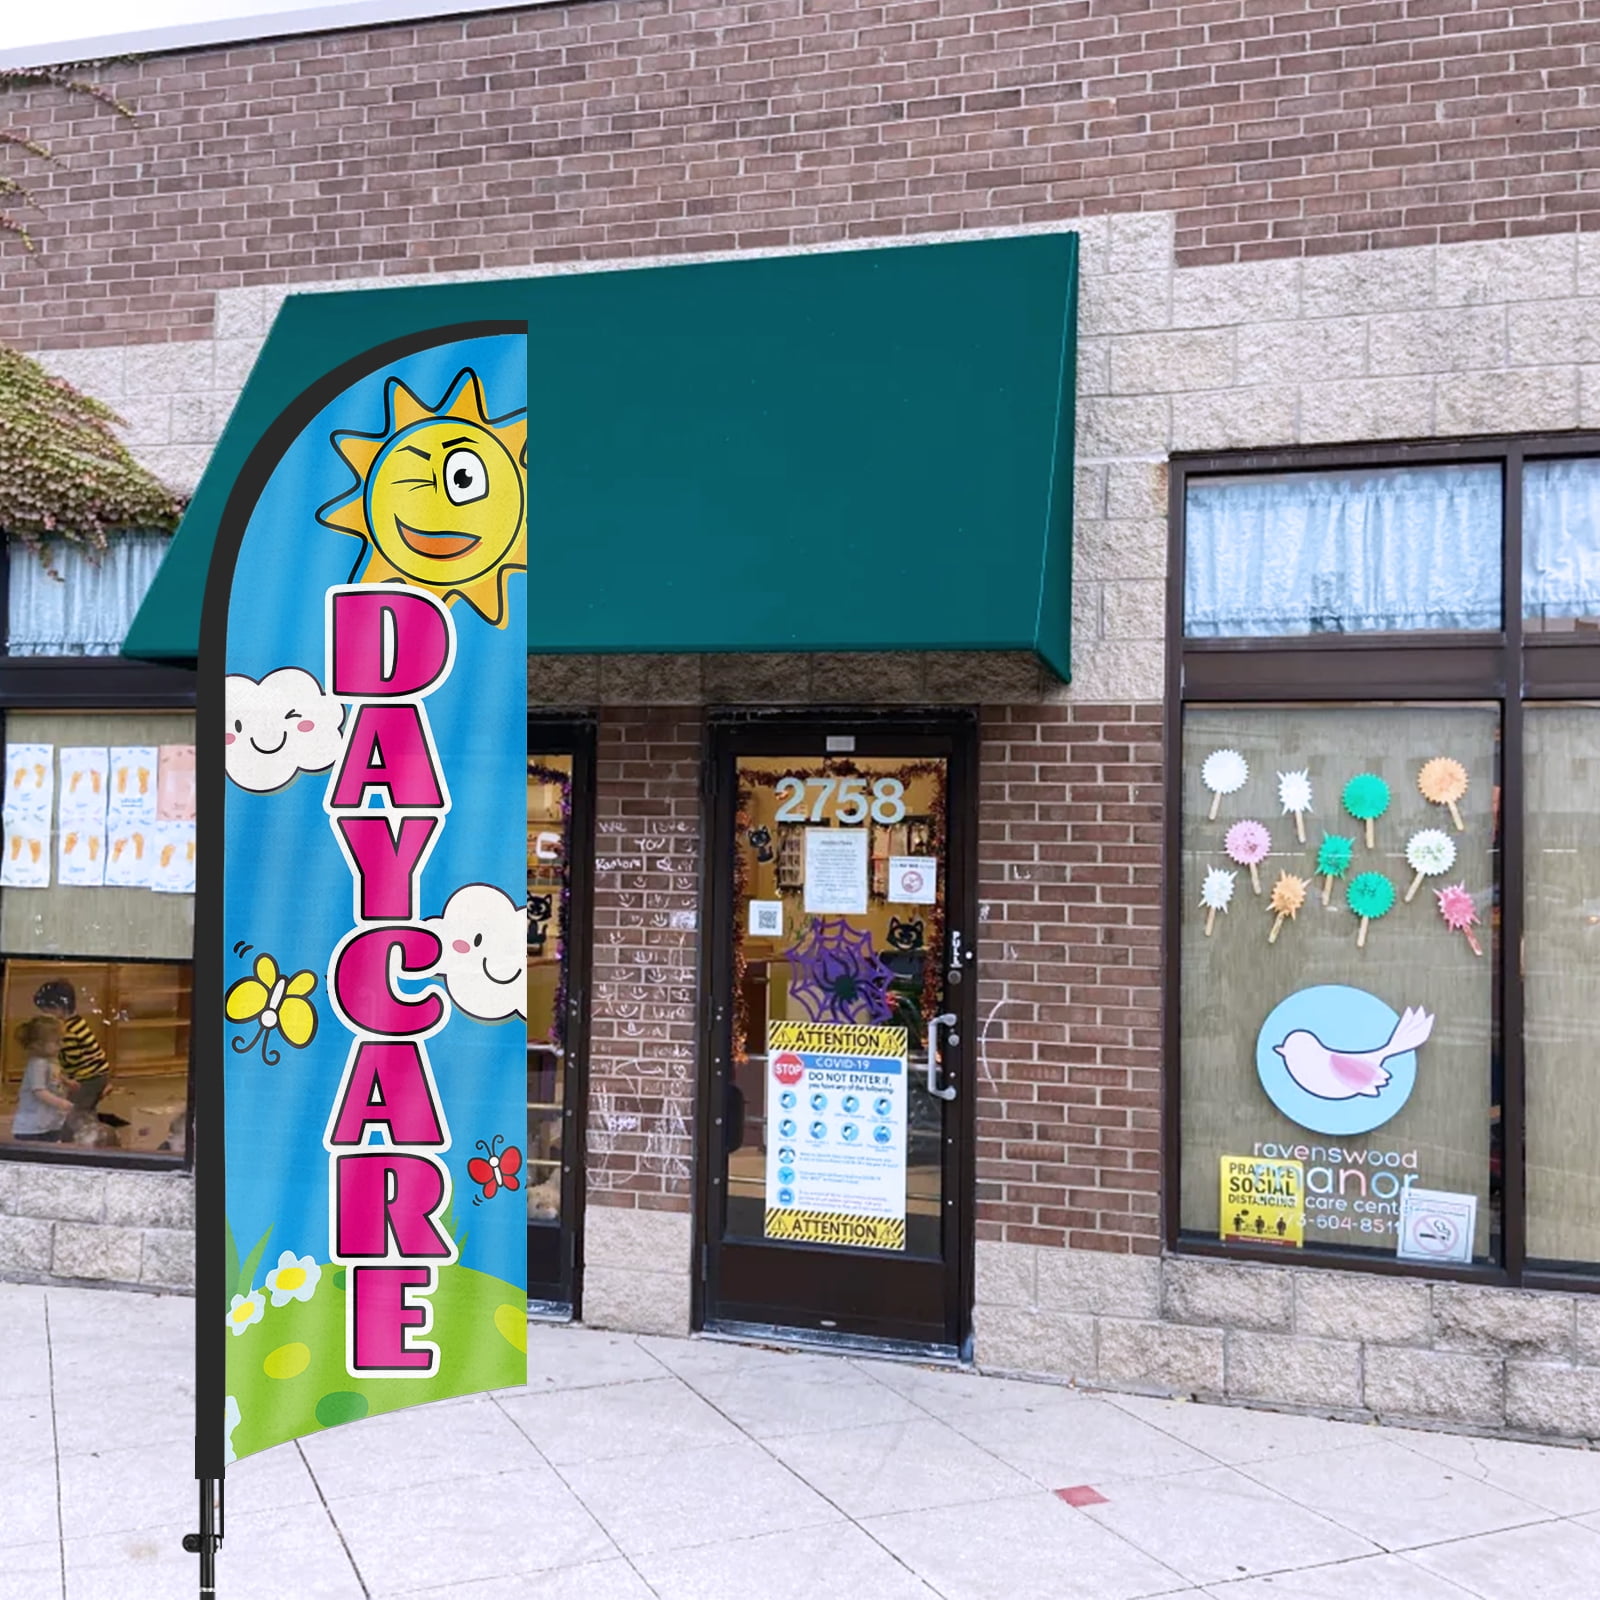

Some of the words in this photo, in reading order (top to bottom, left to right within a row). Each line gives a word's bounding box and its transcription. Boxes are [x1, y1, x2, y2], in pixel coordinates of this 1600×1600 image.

[774, 777, 906, 824] 2758
[952, 931, 961, 965] PULL
[328, 586, 455, 1375] DAYCARE
[795, 1030, 879, 1048] ATTENTION
[774, 1063, 801, 1076] STOP
[815, 1056, 871, 1070] COVID-19
[808, 1071, 824, 1081] DO
[826, 1072, 846, 1083] NOT
[849, 1074, 880, 1085] ENTER
[1254, 1141, 1418, 1169] ravenswood
[1229, 1176, 1295, 1196] SOCIAL
[1305, 1196, 1348, 1212] care
[792, 1218, 878, 1239] ATTENTION
